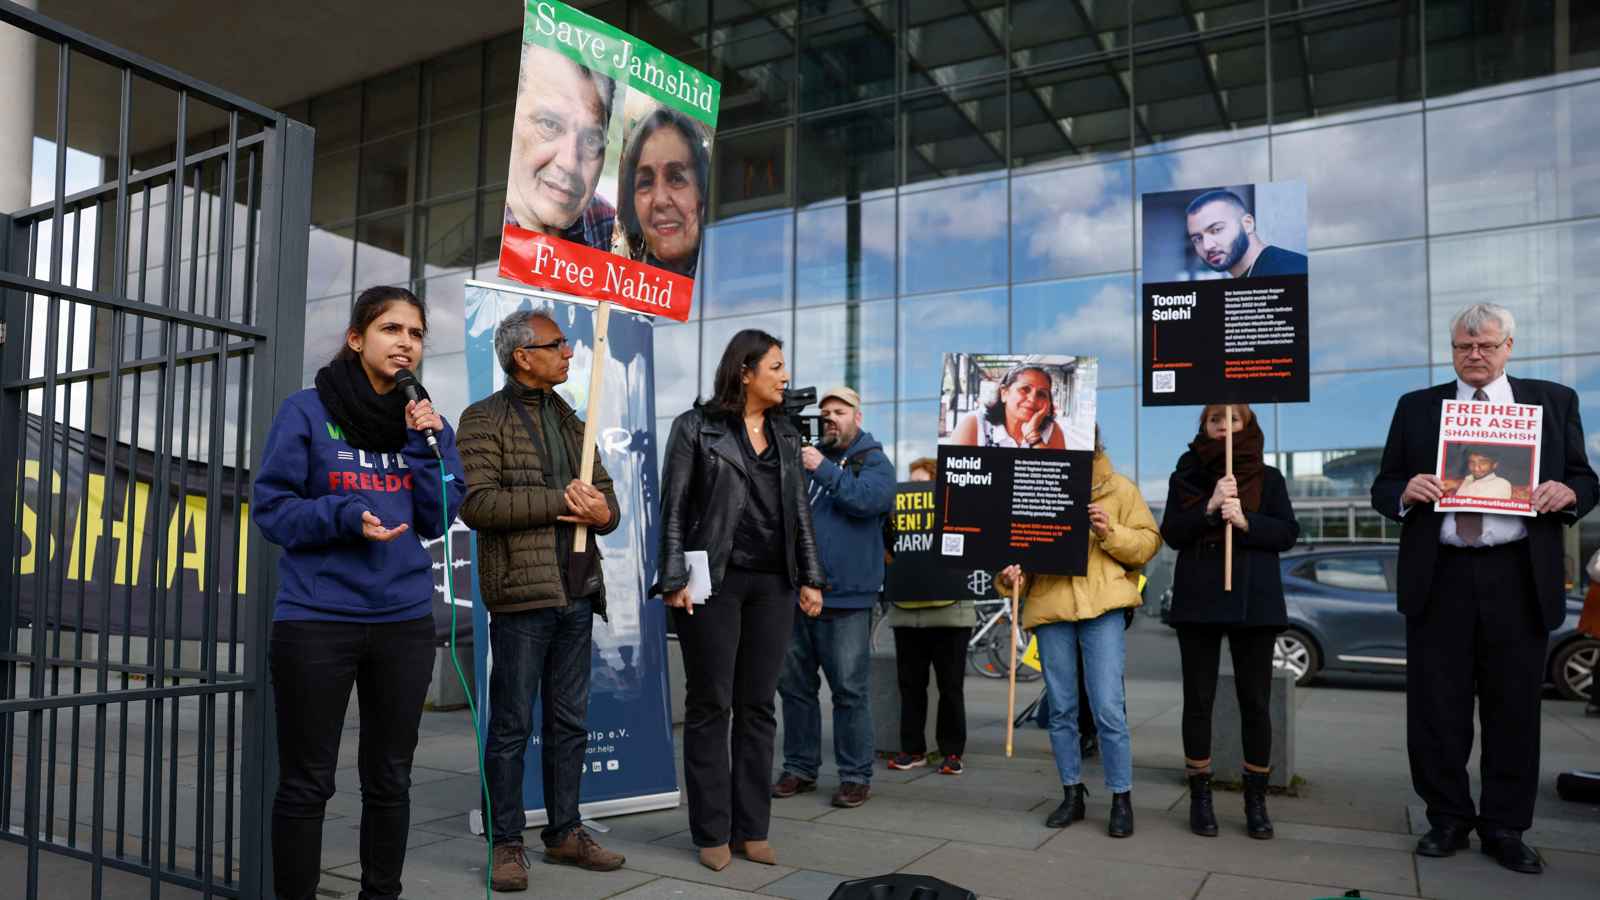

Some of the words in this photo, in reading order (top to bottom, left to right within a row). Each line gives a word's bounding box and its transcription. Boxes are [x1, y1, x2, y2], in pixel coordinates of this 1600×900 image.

[535, 1, 606, 60] Save
[612, 39, 713, 113] Jamshid
[530, 242, 594, 288] Free
[601, 262, 672, 309] Nahid
[1152, 291, 1197, 307] Toomaj
[1152, 307, 1191, 321] Salehi
[1446, 403, 1537, 417] FREIHEIT
[1445, 415, 1482, 427] FÜR
[1488, 418, 1537, 430] ASEF
[1444, 429, 1537, 441] SHAHBAKHSH
[946, 456, 981, 470] Nahid
[945, 471, 992, 487] Taghavi
[896, 491, 935, 510] RTEIL
[893, 513, 921, 531] EN!
[925, 512, 935, 530] J
[893, 533, 934, 552] HARM
